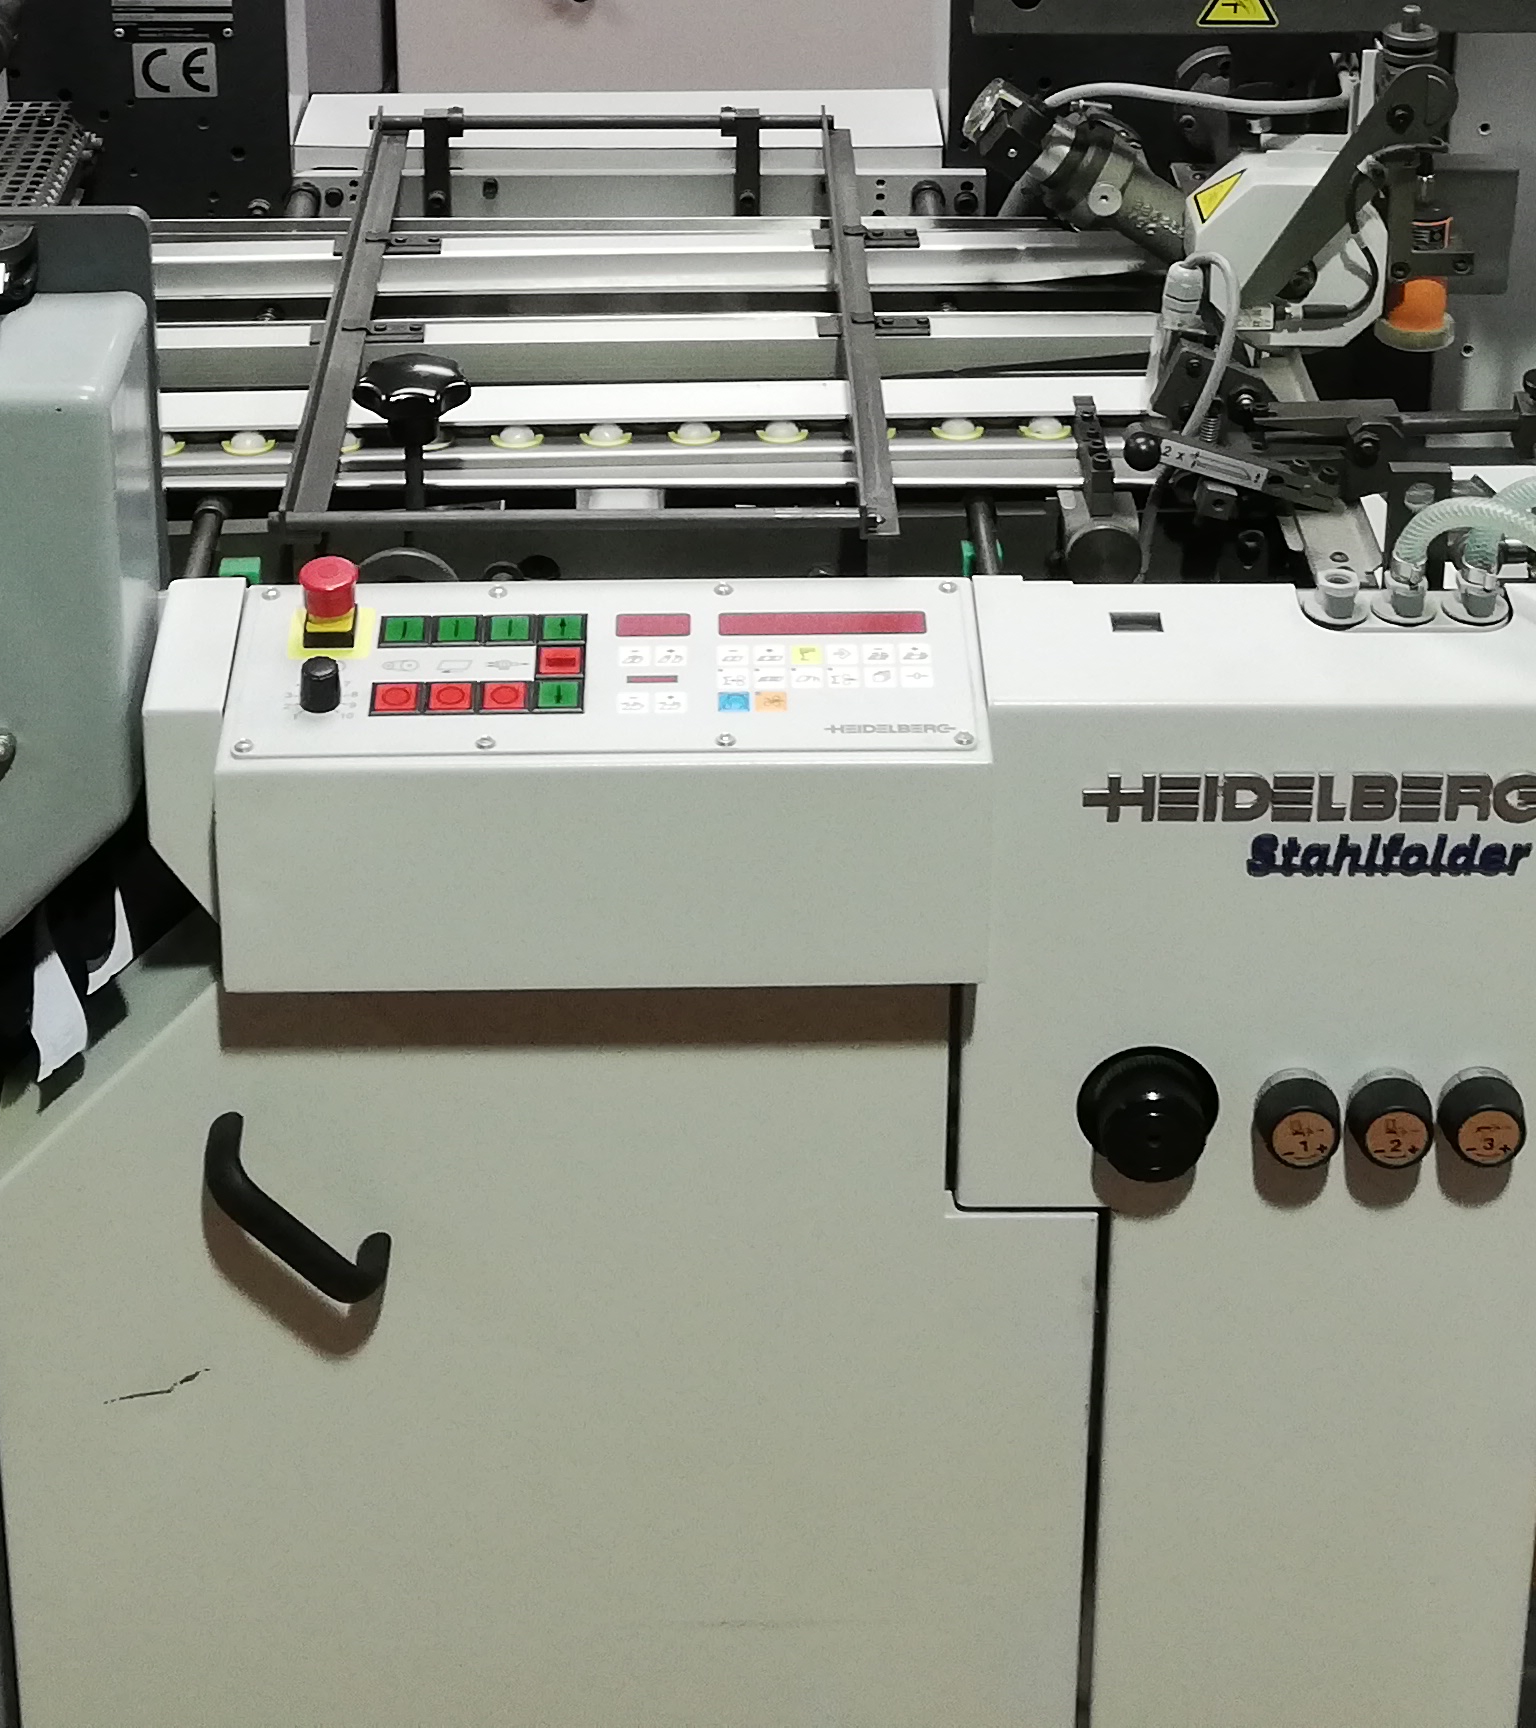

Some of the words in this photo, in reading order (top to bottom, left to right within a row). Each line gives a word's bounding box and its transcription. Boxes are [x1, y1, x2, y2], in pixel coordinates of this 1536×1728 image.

[141, 47, 211, 93] CE
[824, 723, 957, 734] HEIDELBERG
[1247, 832, 1532, 878] Stahlfolder
[1389, 1139, 1402, 1152] 2
[1483, 1137, 1495, 1151] 3
